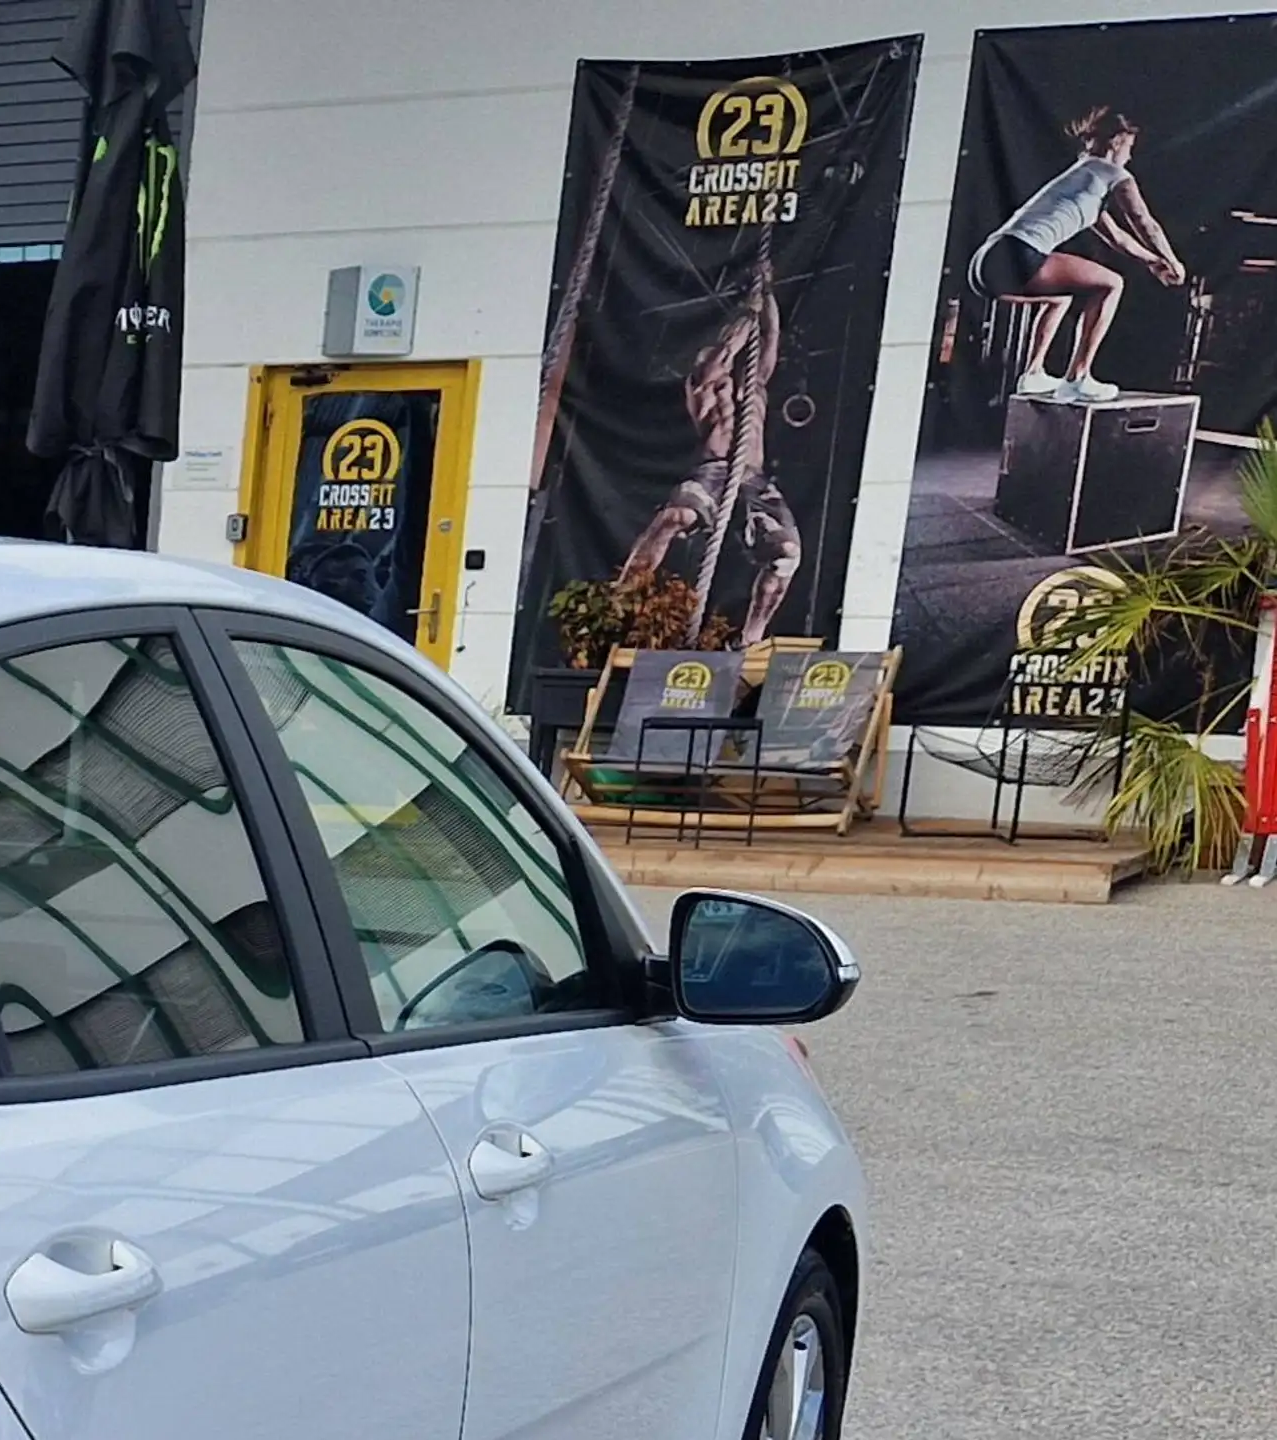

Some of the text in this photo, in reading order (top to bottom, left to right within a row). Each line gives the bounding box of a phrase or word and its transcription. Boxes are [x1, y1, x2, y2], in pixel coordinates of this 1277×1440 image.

[719, 93, 785, 157] 23
[688, 159, 800, 194] CROSSFIT
[684, 192, 798, 226] AREA23
[338, 434, 384, 480] 23
[318, 484, 396, 506] CROSSFIT
[317, 507, 395, 530] AREA23
[675, 668, 703, 689] 23
